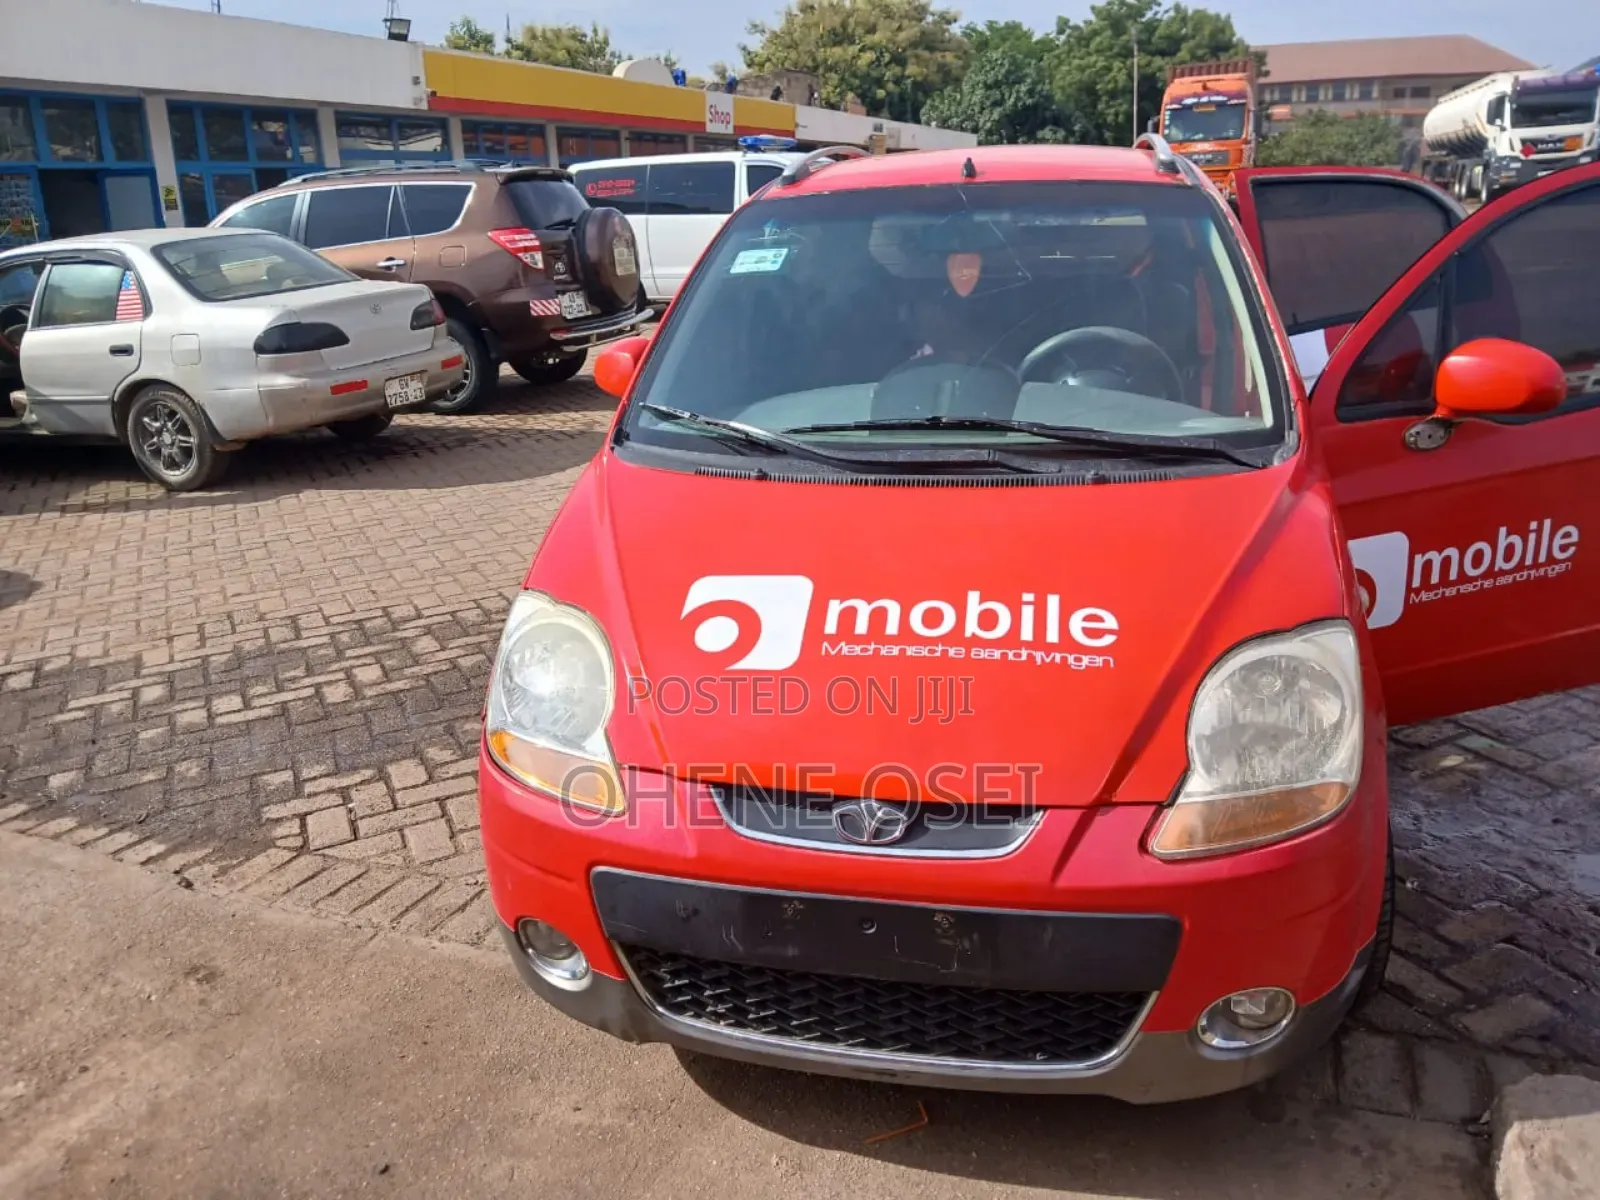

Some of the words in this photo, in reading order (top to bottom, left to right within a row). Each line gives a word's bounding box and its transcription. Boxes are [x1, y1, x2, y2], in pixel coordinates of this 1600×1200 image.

[708, 103, 731, 130] Shop
[1412, 519, 1579, 588] mobile
[1409, 577, 1494, 605] Mechanische
[822, 590, 1120, 648] mobile
[820, 639, 966, 660] Mechanische
[970, 645, 1115, 671] aandrijvingen
